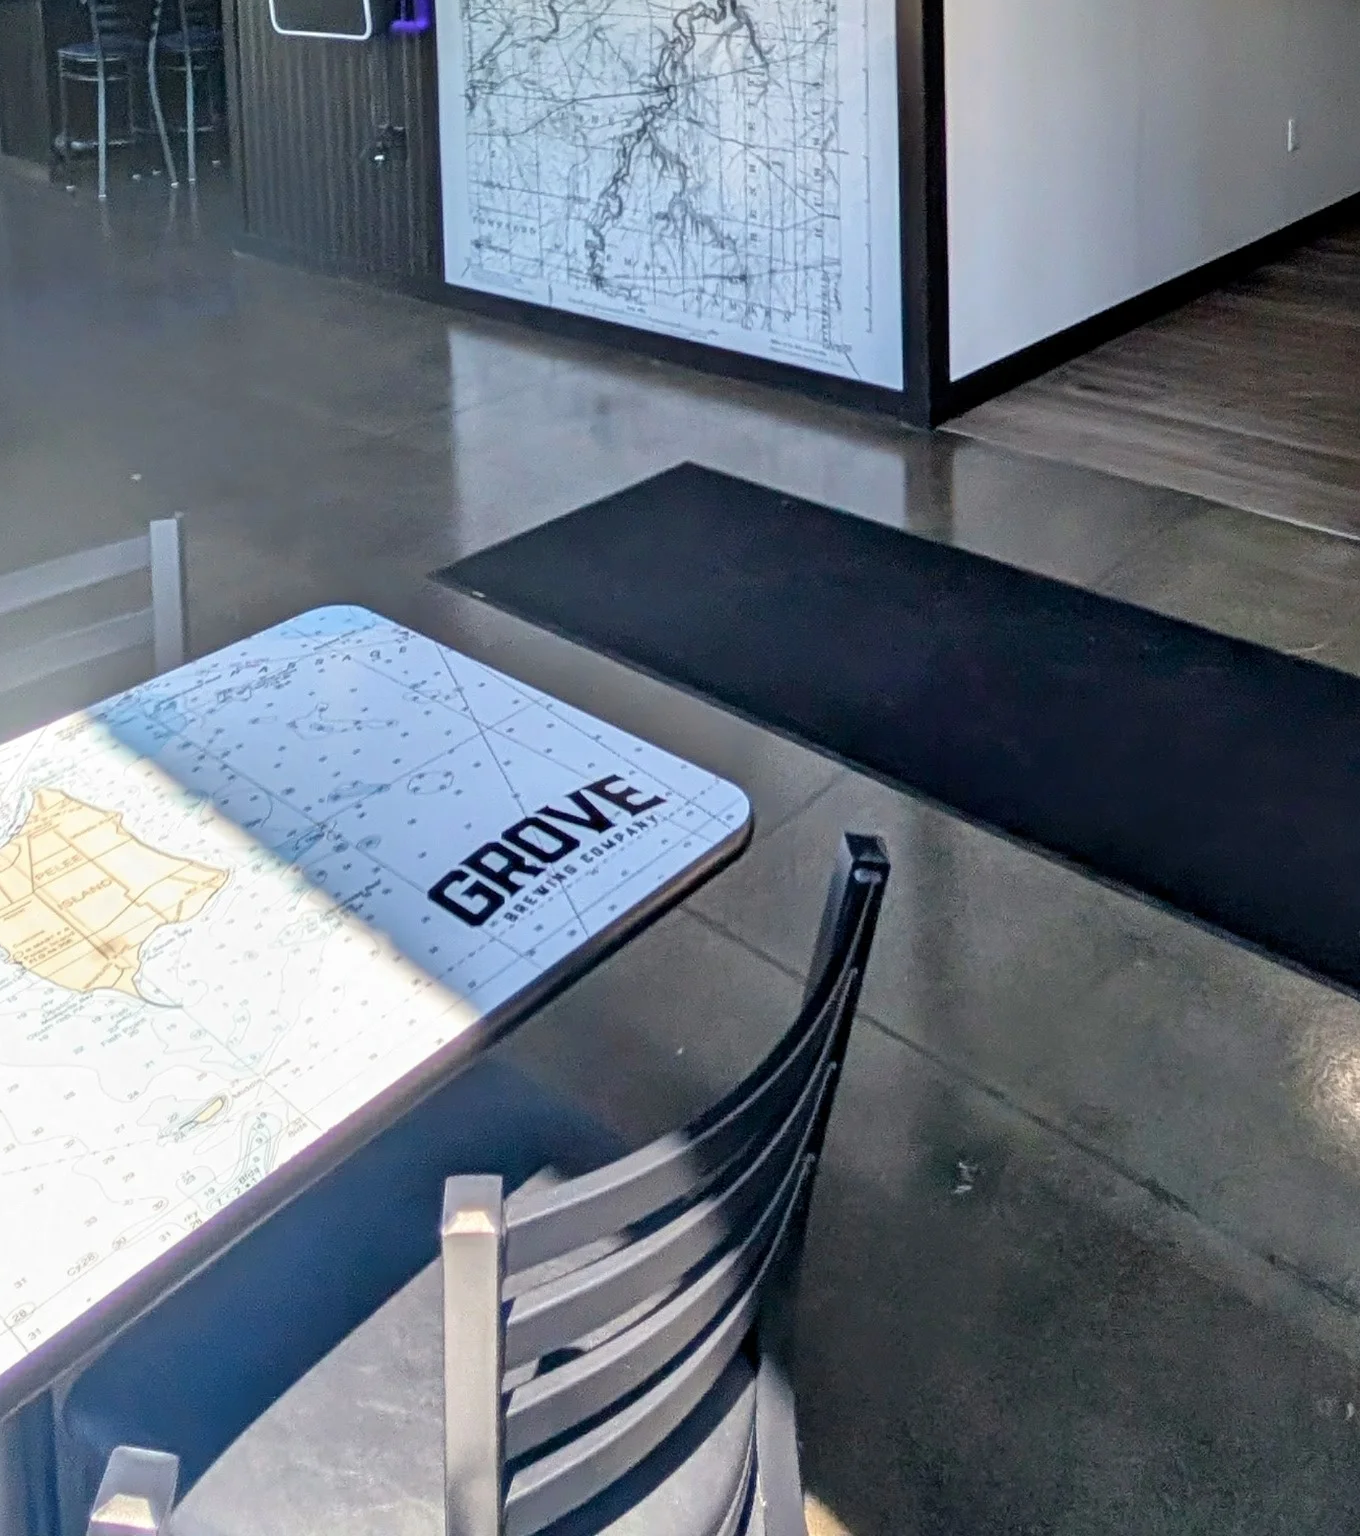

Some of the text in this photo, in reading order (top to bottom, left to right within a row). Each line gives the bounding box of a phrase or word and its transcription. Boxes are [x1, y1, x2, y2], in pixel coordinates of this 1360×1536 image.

[427, 773, 668, 927] GROVE
[504, 814, 659, 923] BREWING COMPANY
